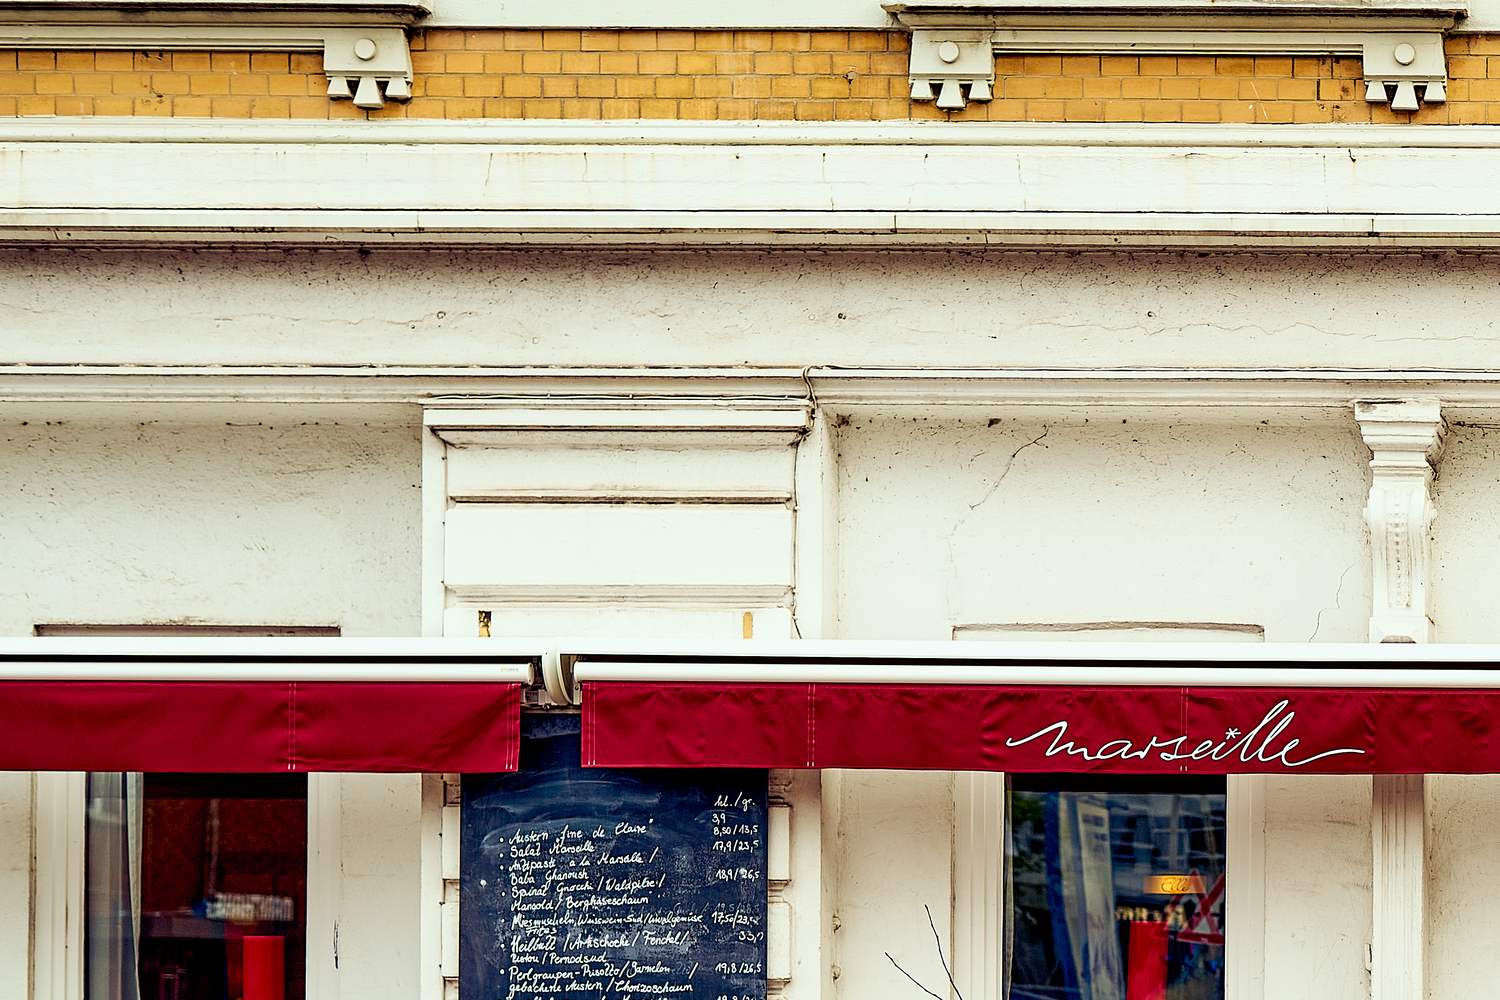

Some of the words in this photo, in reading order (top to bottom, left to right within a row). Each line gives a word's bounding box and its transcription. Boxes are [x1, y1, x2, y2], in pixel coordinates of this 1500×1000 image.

[1006, 699, 1366, 766] marseille
[712, 813, 726, 825] 3,9
[509, 829, 548, 844] Austern
[593, 825, 605, 839] de
[713, 824, 758, 837] 8,50/13,5
[510, 843, 541, 858] Salat
[713, 839, 759, 853] 17,9/23,5
[509, 857, 556, 876] Antipasti
[579, 855, 590, 866] la
[510, 872, 535, 886] Baba
[545, 868, 589, 889] Ghanoush
[511, 885, 547, 904] Spinat
[556, 881, 594, 900] Gnocchi
[511, 936, 556, 953] Heilbutt
[715, 962, 762, 974] 19,8/26,5
[566, 979, 603, 992] Austern
